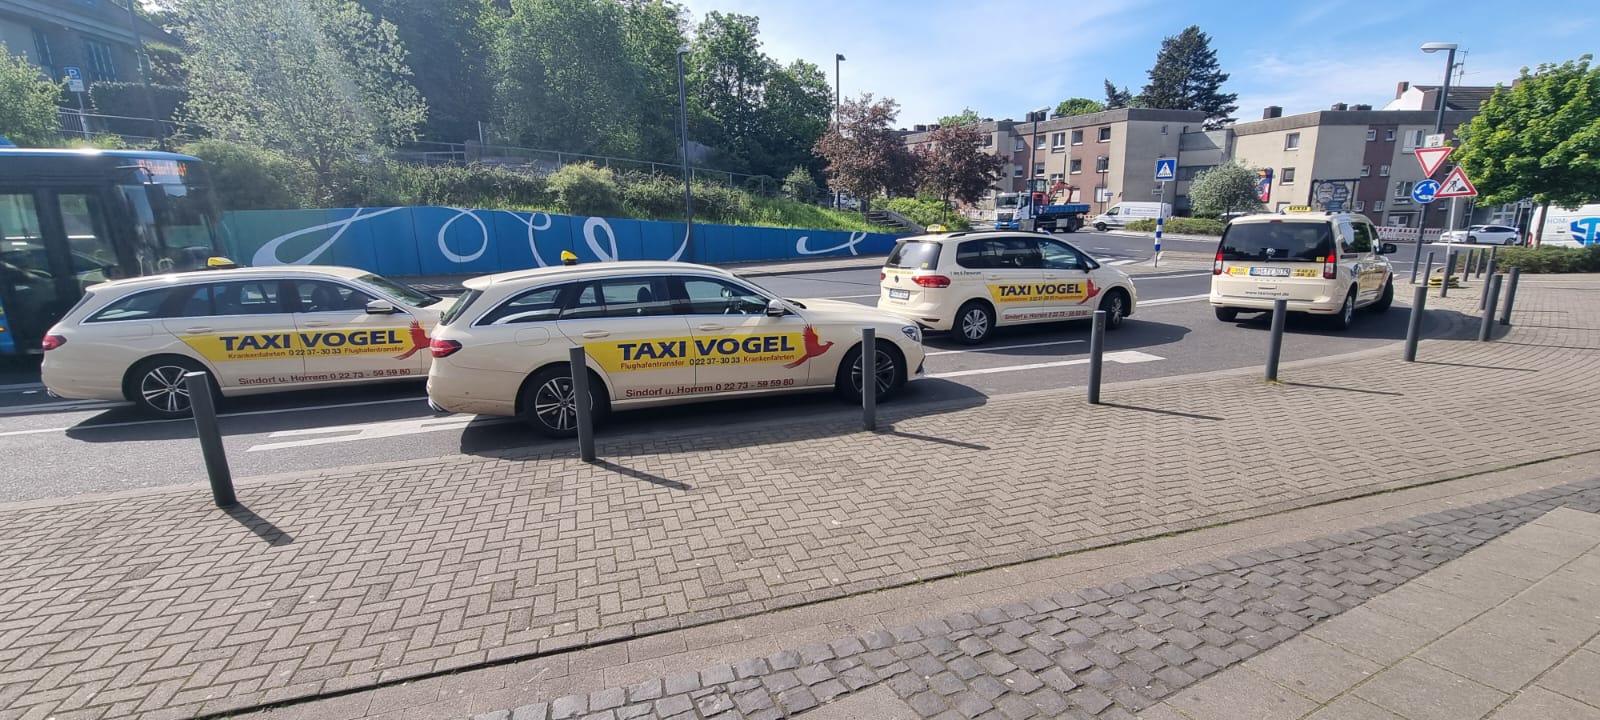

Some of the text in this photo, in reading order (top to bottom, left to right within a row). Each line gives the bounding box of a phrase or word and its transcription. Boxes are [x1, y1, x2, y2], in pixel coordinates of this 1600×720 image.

[999, 283, 1081, 296] TAXI VOGEL
[219, 330, 403, 351] TAXI VOGEL
[228, 351, 286, 359] Krankenfahrten
[344, 346, 404, 354] Flughafentransfer
[617, 336, 795, 361] TAXI VOGEL
[621, 360, 685, 370] Flughafentransfer
[743, 354, 794, 362] Krankenfahrten
[238, 376, 275, 385] Sindorf
[625, 388, 662, 397] Sindorf
[676, 385, 713, 394] Horrem
